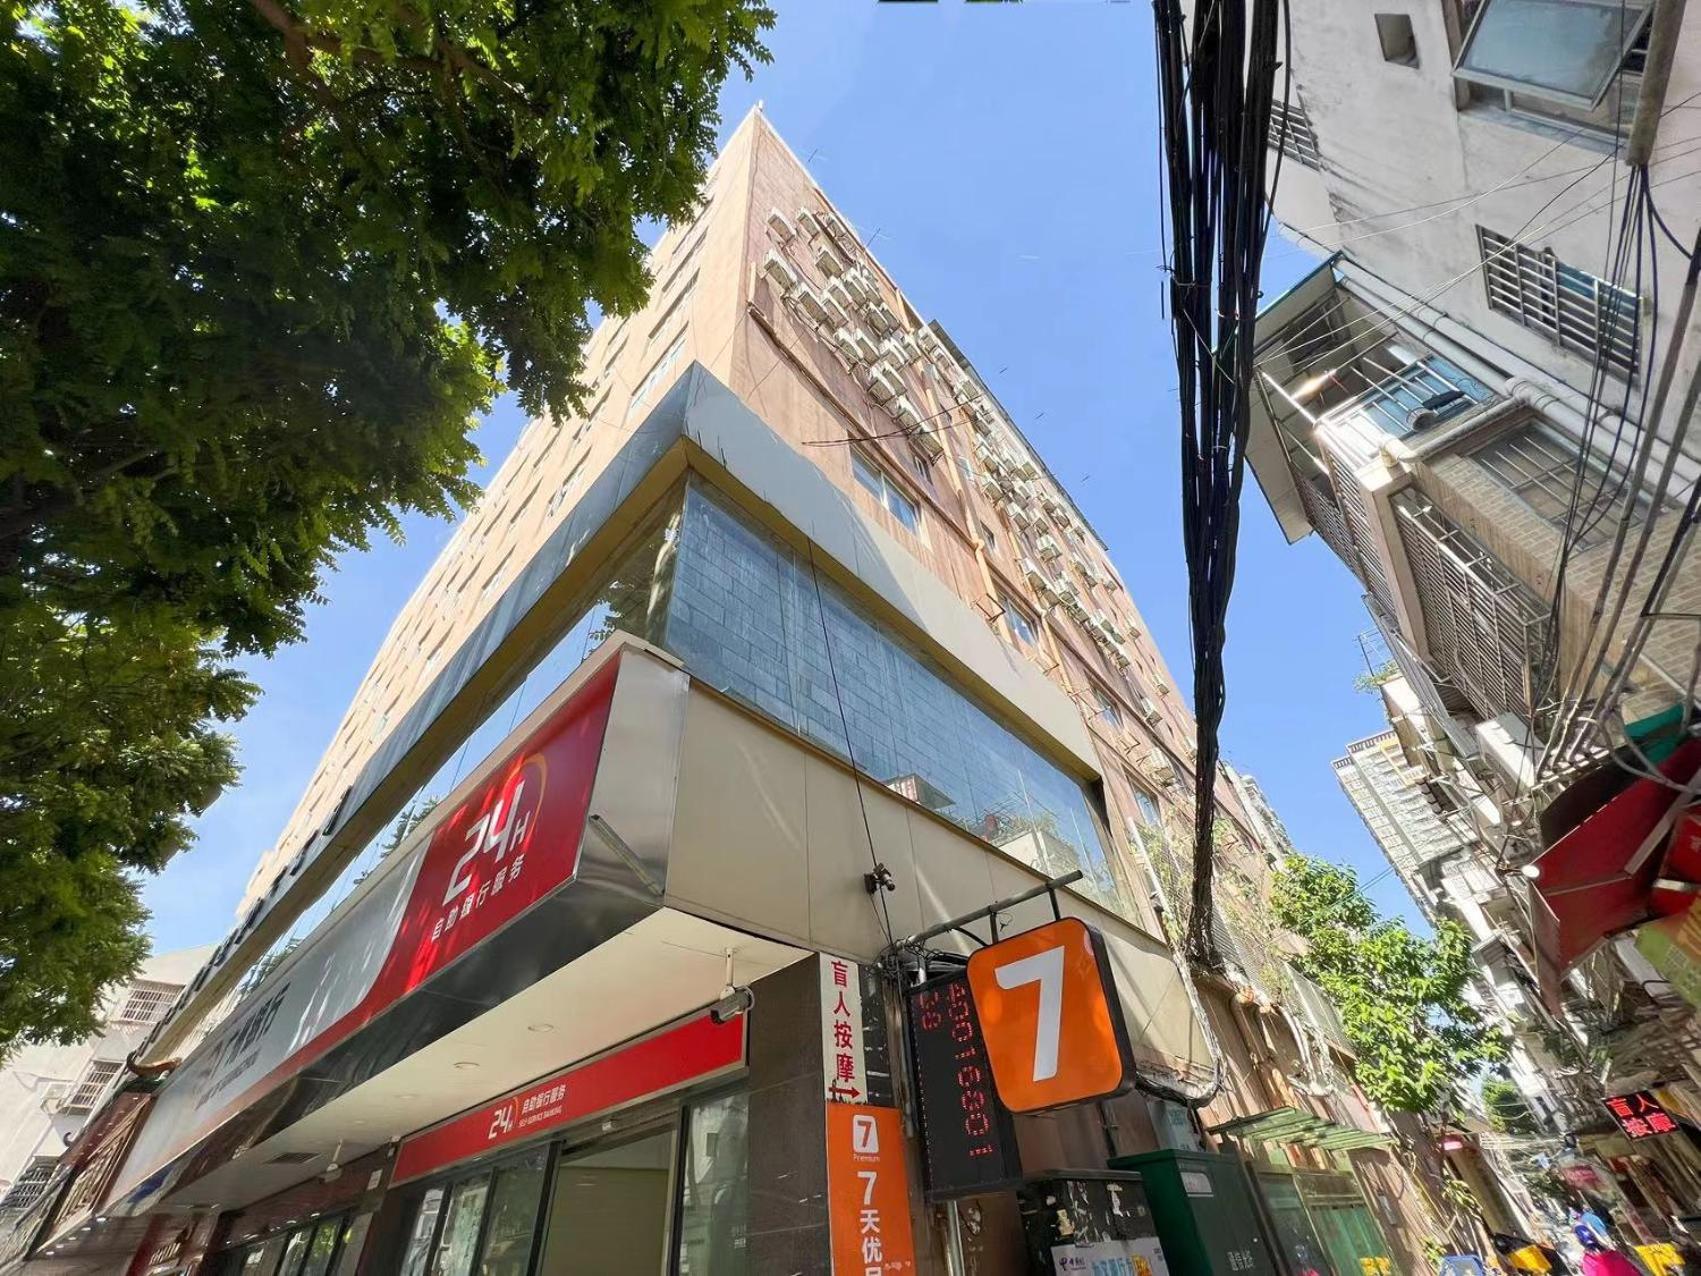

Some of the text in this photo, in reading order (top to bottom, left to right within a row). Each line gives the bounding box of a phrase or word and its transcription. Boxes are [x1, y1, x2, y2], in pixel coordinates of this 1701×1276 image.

[431, 853, 525, 943] 自助银行服务
[831, 960, 855, 1083] 盲人按摩
[995, 946, 1065, 1082] 7
[857, 1120, 872, 1148] 7
[1606, 1094, 1659, 1119] 盲人
